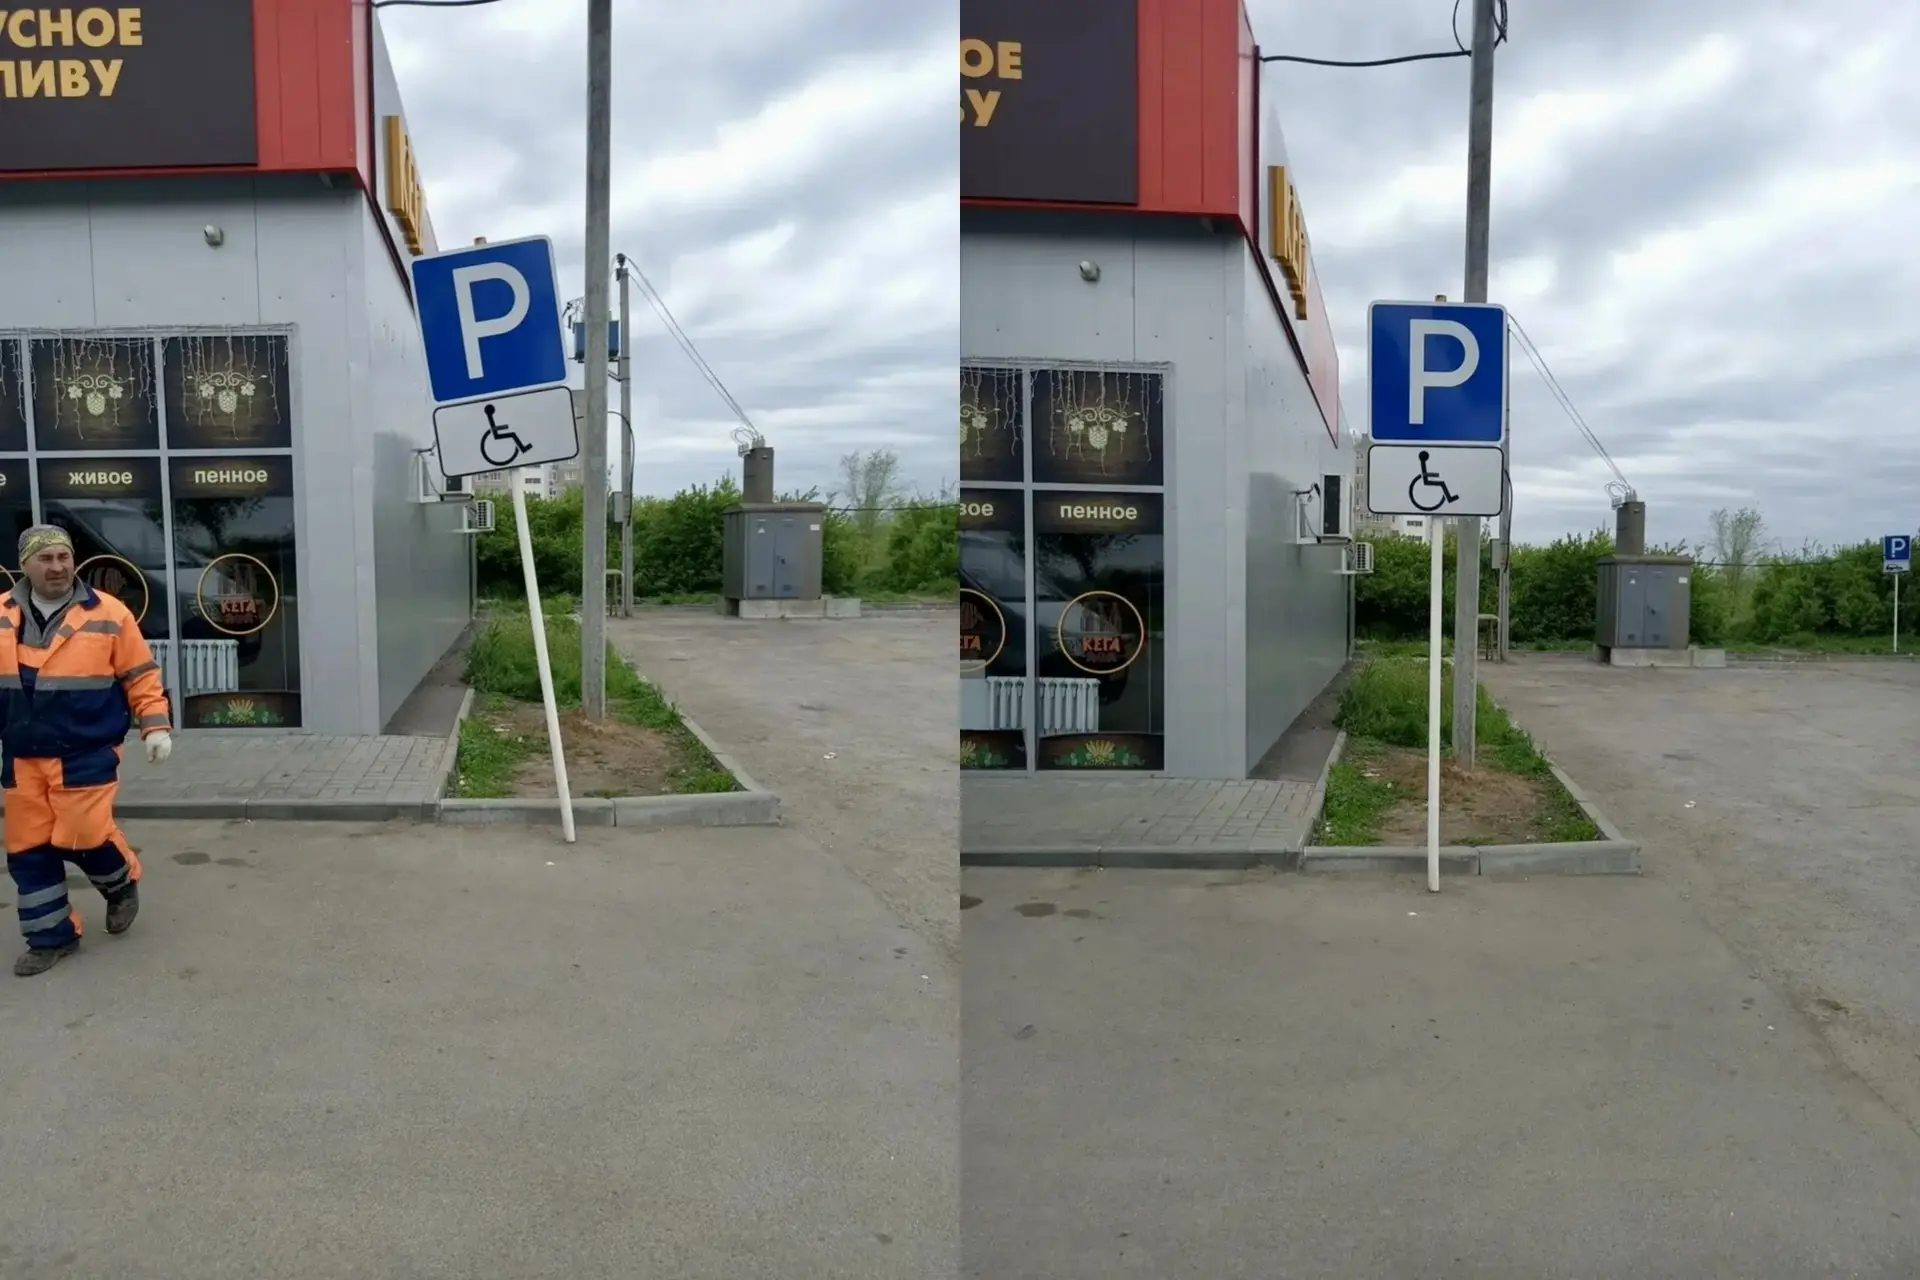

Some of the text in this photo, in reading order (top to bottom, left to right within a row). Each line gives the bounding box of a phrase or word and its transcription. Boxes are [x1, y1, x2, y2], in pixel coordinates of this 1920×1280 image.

[0, 8, 143, 48] СНОЕ
[960, 89, 1001, 127] У
[452, 262, 530, 380] P
[1409, 319, 1480, 424] P
[69, 470, 133, 485] живое
[195, 468, 268, 483] пенное
[1060, 504, 1138, 519] пенное
[1891, 538, 1906, 558] P
[1083, 635, 1121, 652] КЕГА
